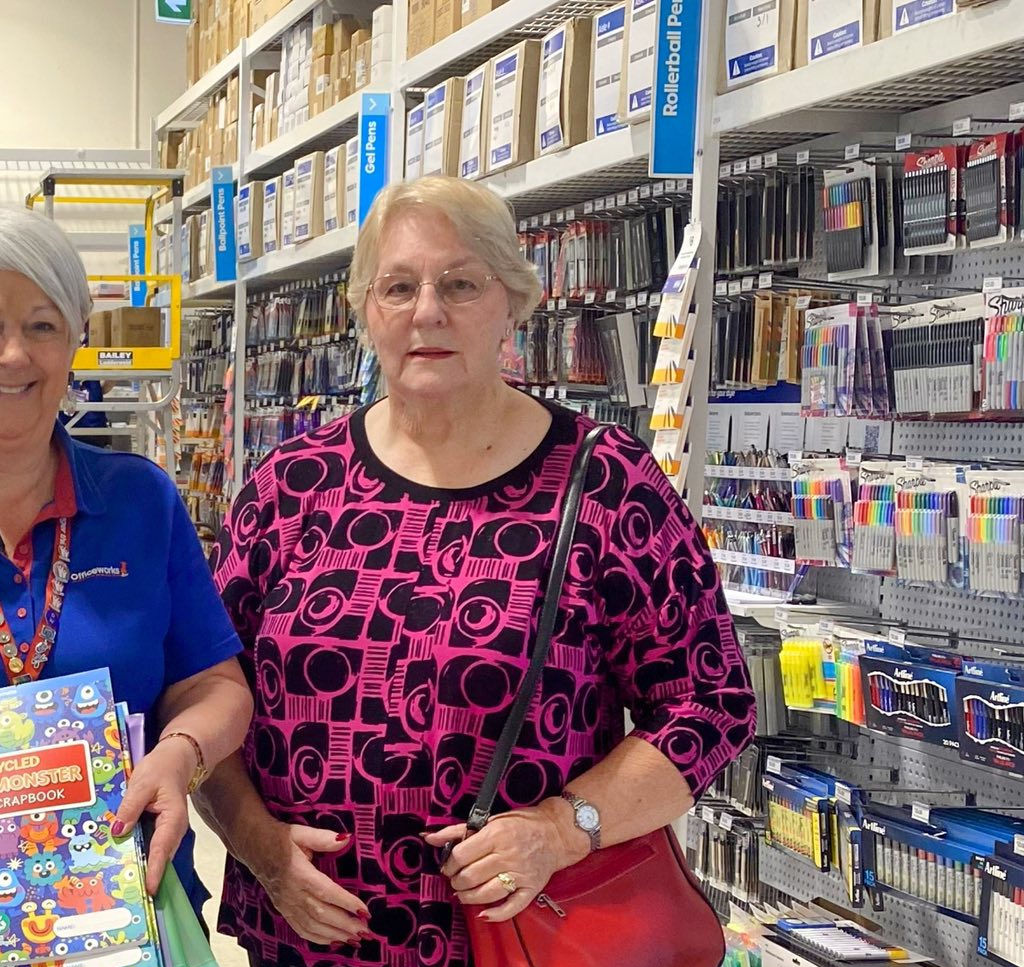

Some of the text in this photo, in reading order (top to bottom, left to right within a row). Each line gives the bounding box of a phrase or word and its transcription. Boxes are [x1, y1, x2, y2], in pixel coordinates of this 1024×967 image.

[662, 0, 683, 117] Rollerball Pe
[364, 121, 377, 174] Gel Pens
[217, 187, 227, 252] Ballpoint Pens
[133, 259, 141, 292] Baoint
[99, 351, 132, 359] BAILEY
[70, 566, 120, 581] Officeworks
[893, 667, 913, 680] Artline
[989, 690, 1010, 704] Artline
[861, 818, 886, 836] Artline
[864, 870, 875, 881] 15
[984, 861, 1007, 881] Artline
[979, 936, 987, 949] 15
